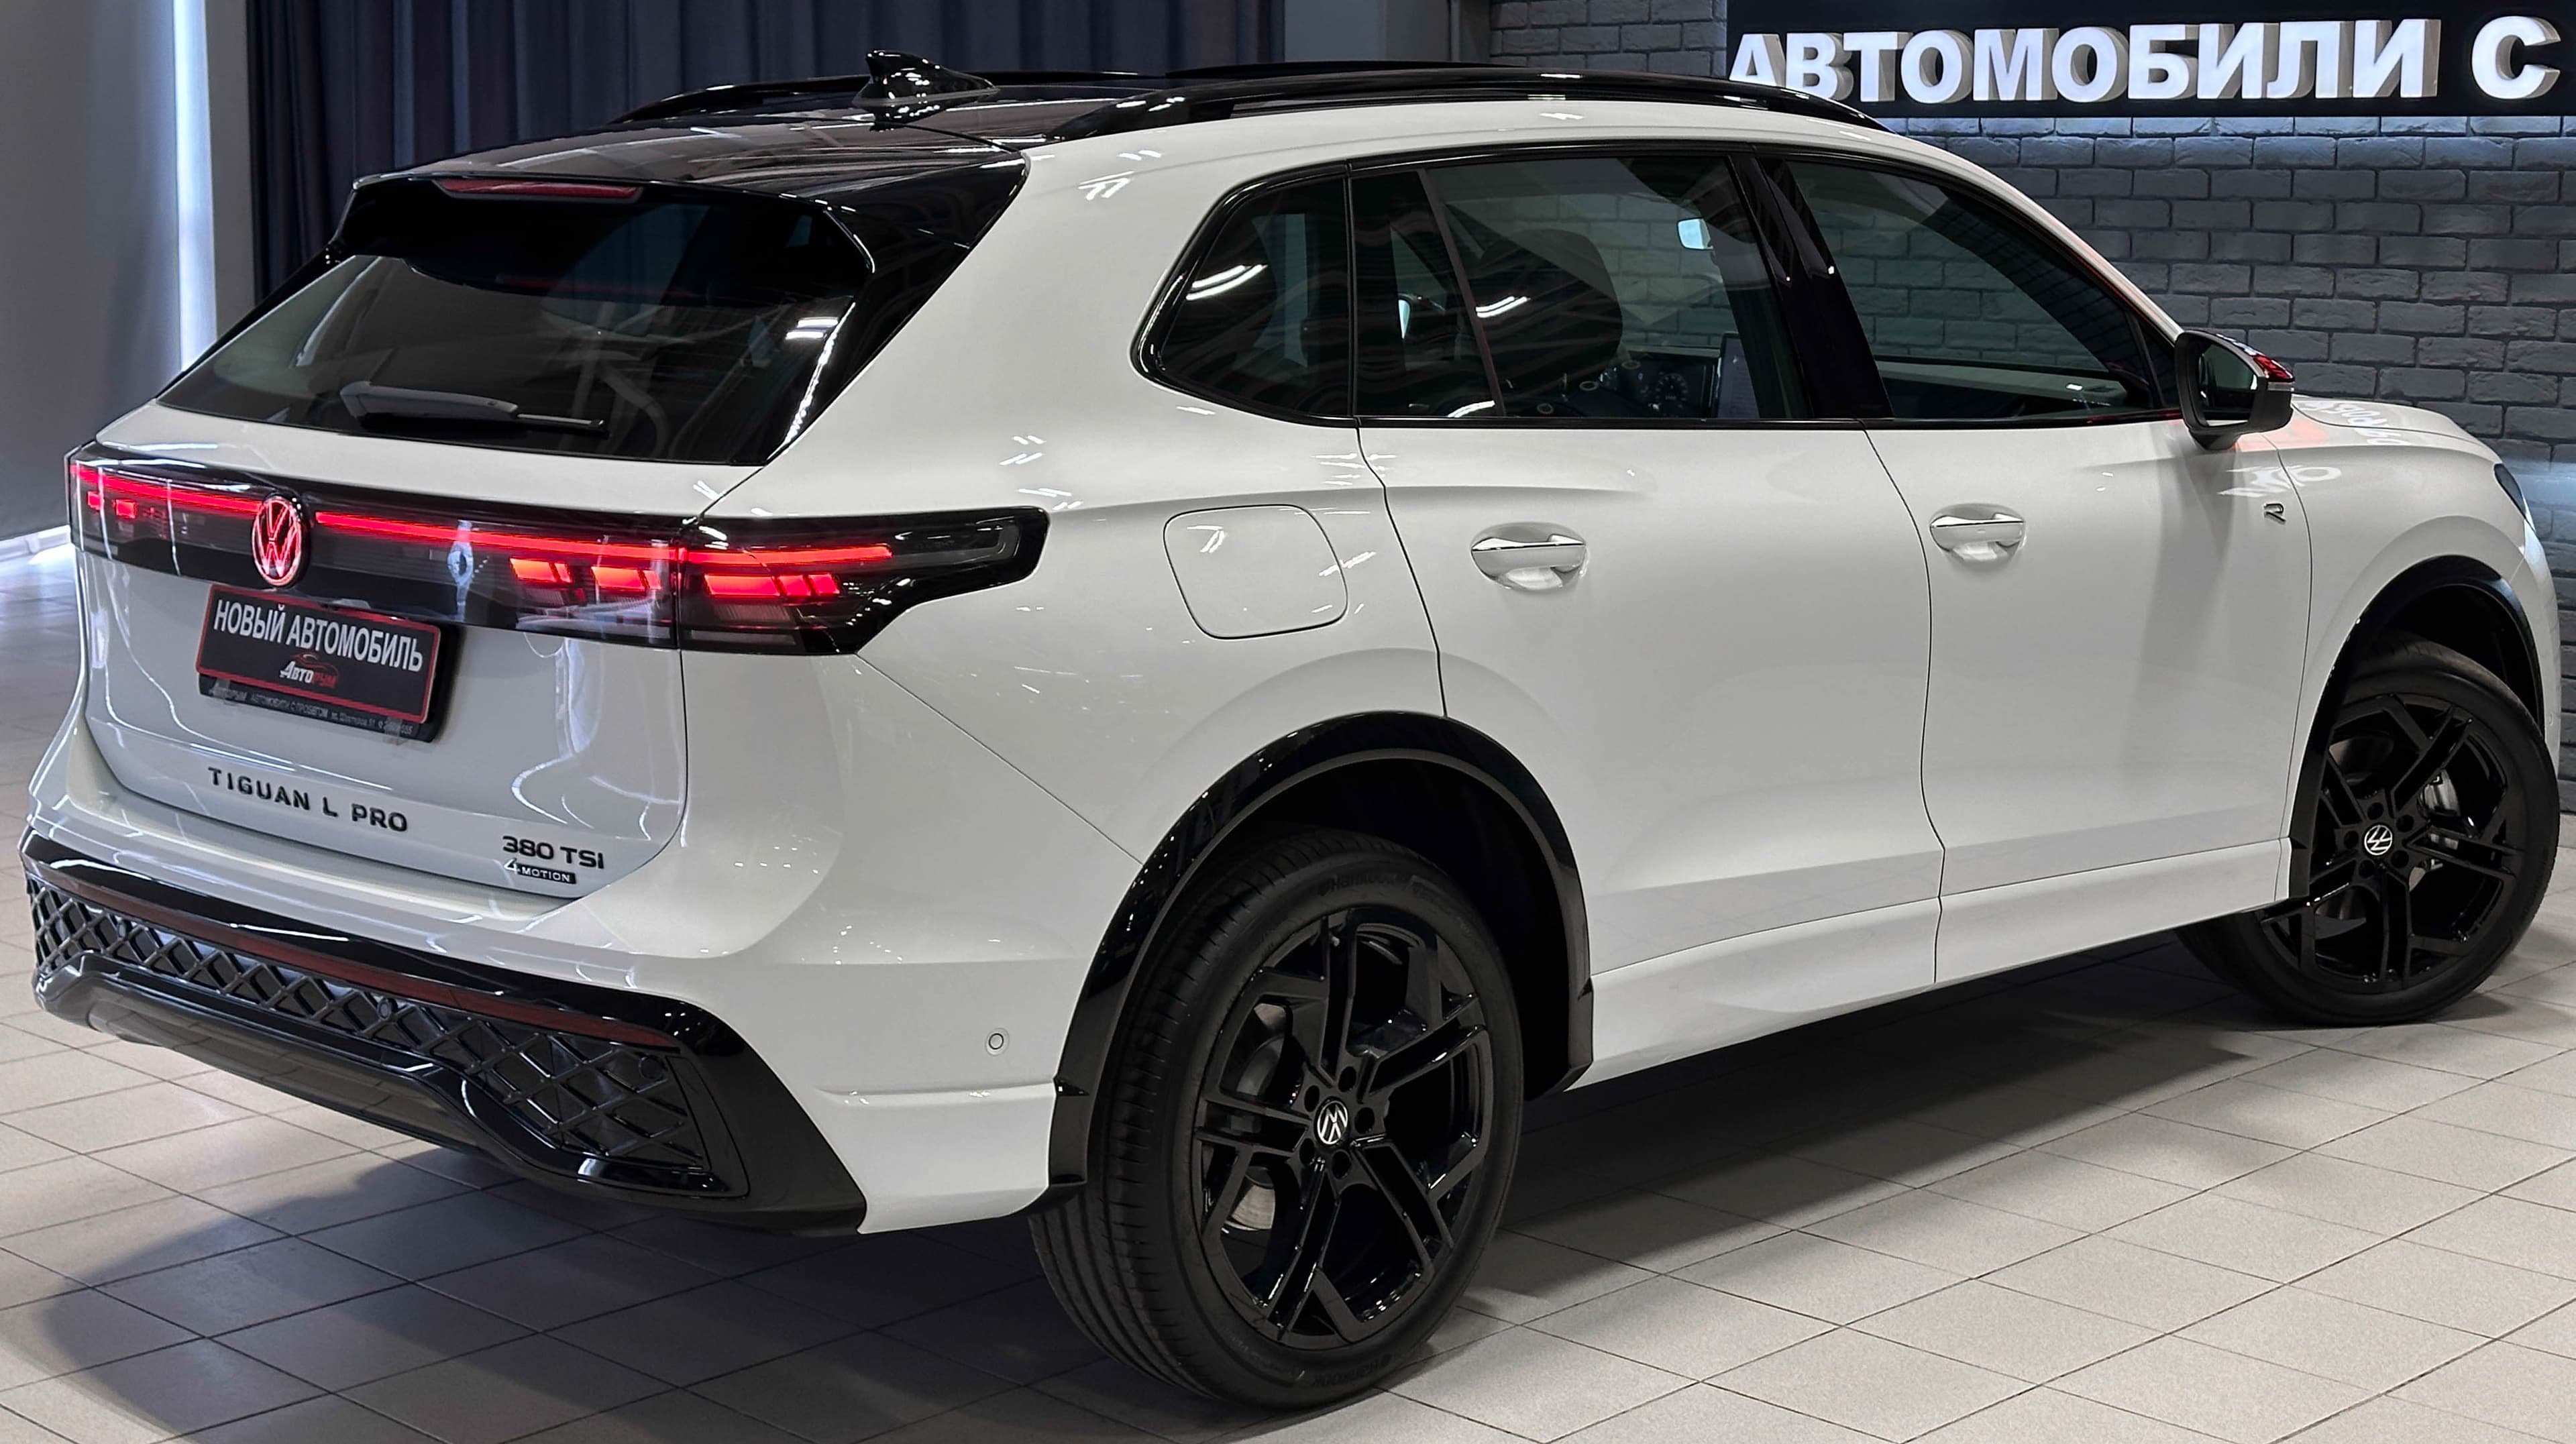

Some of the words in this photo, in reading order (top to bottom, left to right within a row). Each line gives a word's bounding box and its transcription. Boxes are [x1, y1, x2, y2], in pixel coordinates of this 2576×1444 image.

[1729, 18, 2440, 103] АВТОМОБИЛИ
[2471, 15, 2560, 99] С
[213, 600, 285, 644] НОВЫЙ
[286, 614, 423, 673] АВТОМОБИЛЬ
[208, 767, 311, 811] TIGUAN
[323, 797, 338, 818] L
[351, 803, 409, 833] PRO
[502, 835, 554, 860] 380
[559, 846, 604, 869] TSI
[504, 858, 571, 883] 4MOTION
